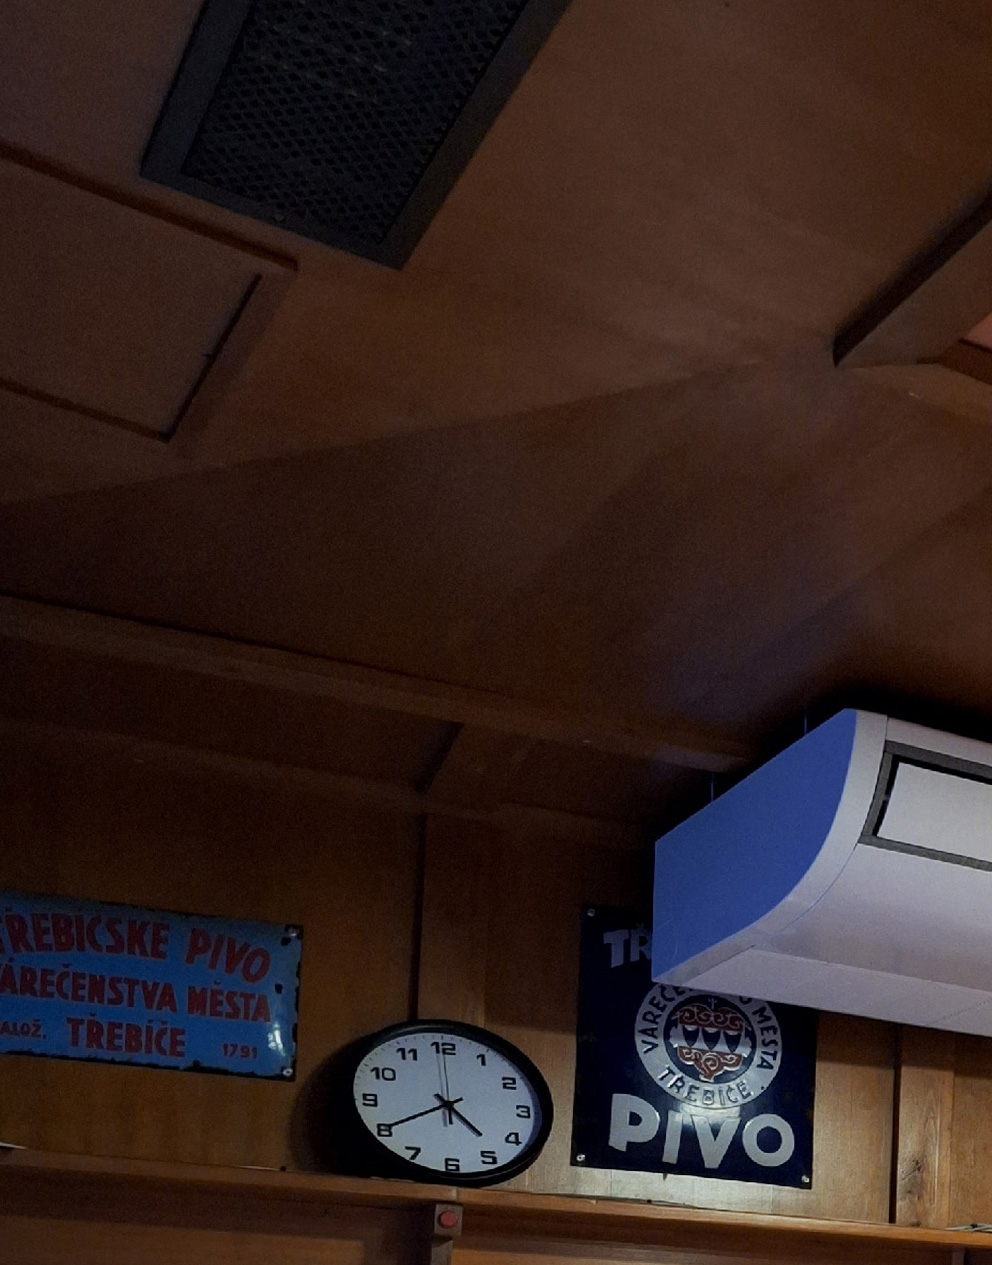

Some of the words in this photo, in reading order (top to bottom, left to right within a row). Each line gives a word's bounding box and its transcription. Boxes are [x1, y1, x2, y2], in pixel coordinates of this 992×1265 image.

[185, 927, 272, 984] PIVO
[0, 957, 178, 1013] ÁREČENSTVA
[187, 980, 272, 1022] MĚSTA
[397, 1048, 418, 1061] 11
[430, 1042, 456, 1055] 12
[476, 1054, 486, 1066] 1
[370, 1067, 396, 1081] 10
[502, 1077, 517, 1090] 2
[362, 1093, 378, 1107] 9
[516, 1105, 531, 1118] 3
[377, 1123, 392, 1137] 8
[608, 1093, 795, 1169] PIVO
[505, 1132, 522, 1146] 4
[405, 1146, 421, 1160] 7
[480, 1150, 497, 1164] 5
[445, 1158, 460, 1171] 6
